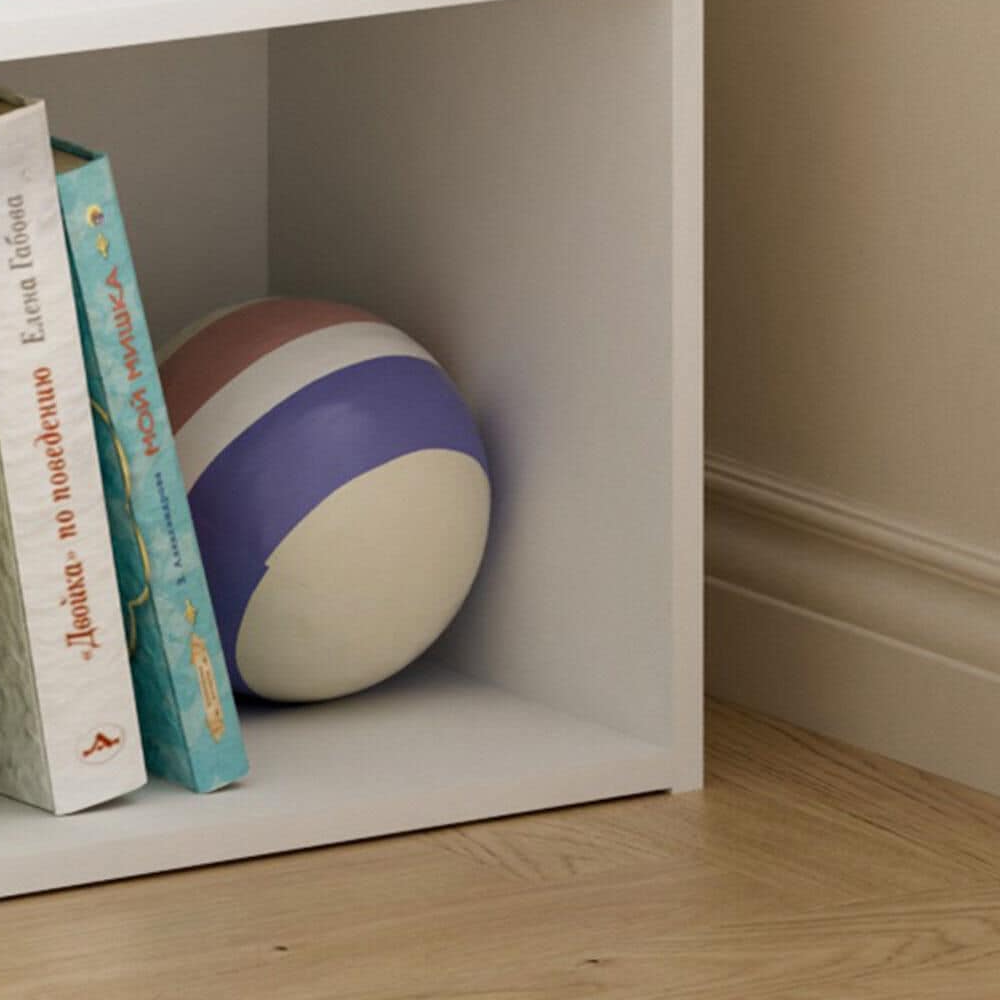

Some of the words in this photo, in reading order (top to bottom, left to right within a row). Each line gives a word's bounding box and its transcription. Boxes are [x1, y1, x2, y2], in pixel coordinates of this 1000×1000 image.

[5, 195, 33, 271] Габова
[21, 277, 44, 346] Елена
[105, 265, 143, 381] МИШКА
[33, 366, 70, 504] поведению
[131, 387, 160, 456] МОЙ
[55, 509, 77, 539] по
[60, 550, 100, 661] «Двойка»
